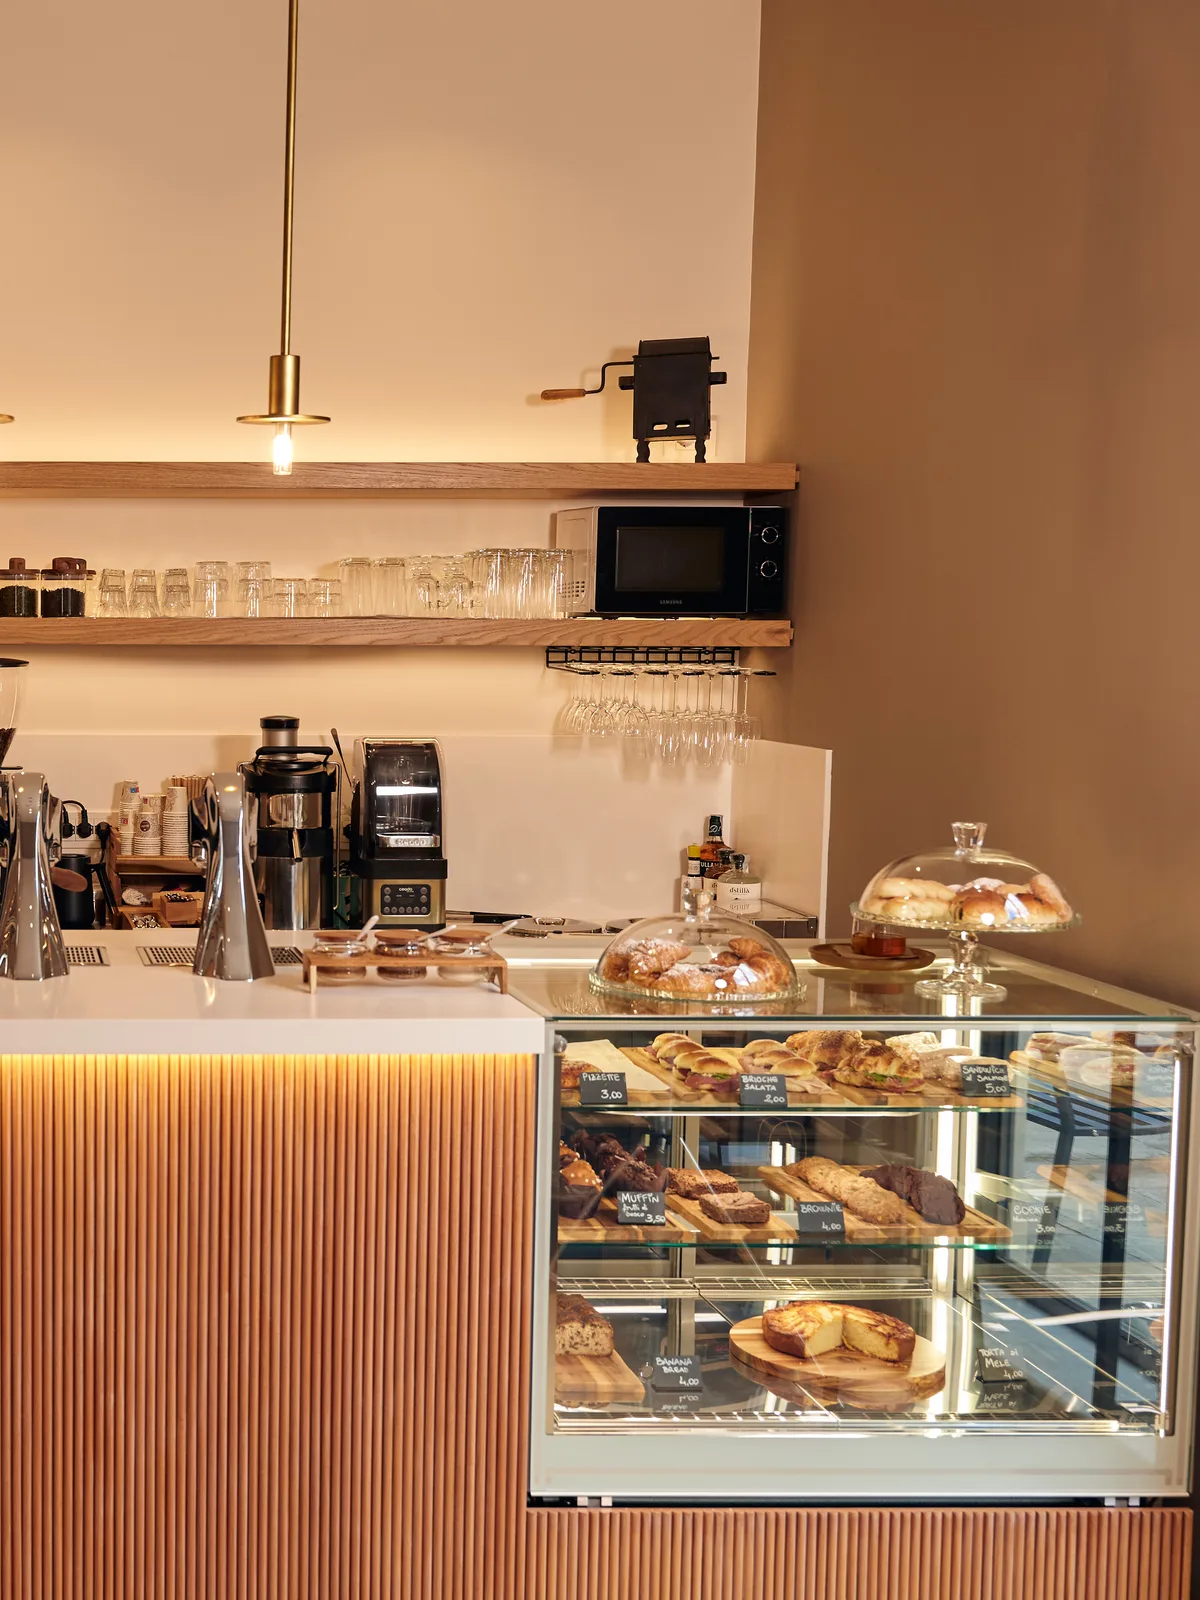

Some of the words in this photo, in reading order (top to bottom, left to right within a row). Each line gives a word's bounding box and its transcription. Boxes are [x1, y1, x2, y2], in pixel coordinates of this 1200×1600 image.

[741, 1075, 778, 1083] BRIOCHE
[979, 1348, 1005, 1357] TORTA
[655, 1357, 692, 1366] BANANA
[985, 1358, 1010, 1368] MELE
